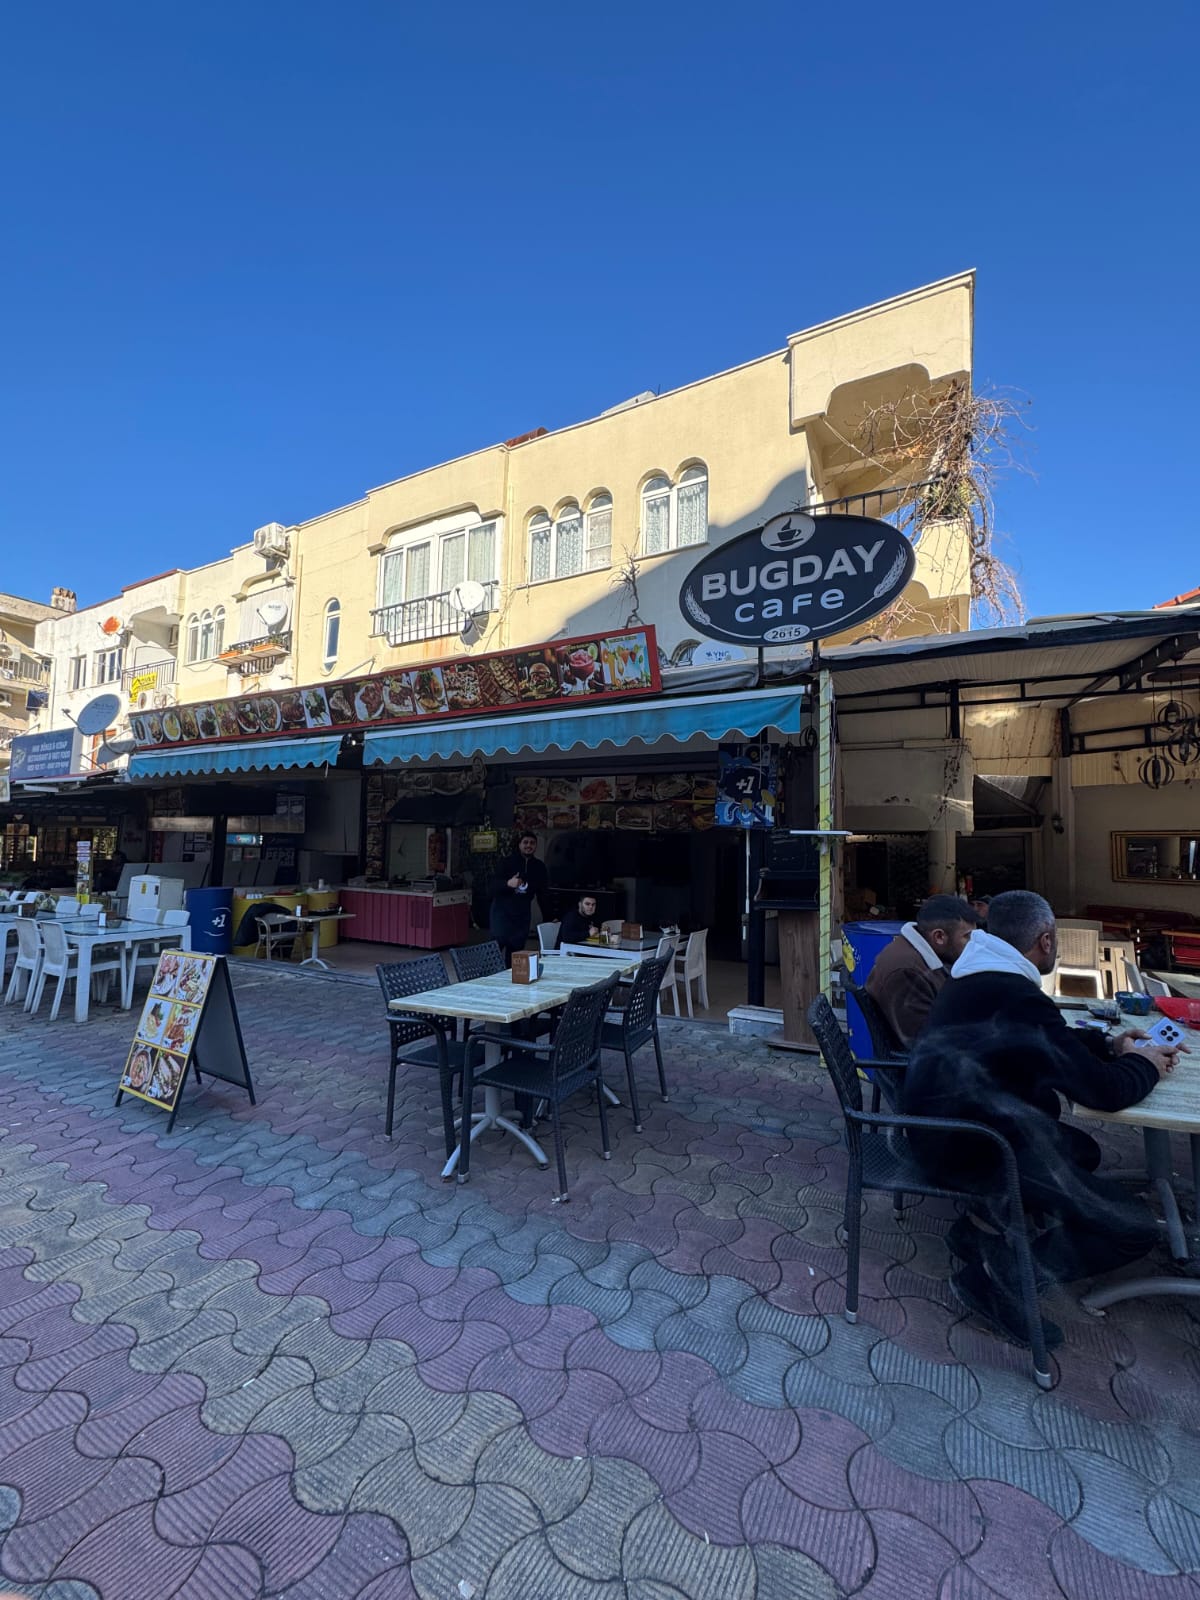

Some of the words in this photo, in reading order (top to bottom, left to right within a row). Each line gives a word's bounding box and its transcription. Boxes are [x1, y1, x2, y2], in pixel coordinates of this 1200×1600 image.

[702, 540, 885, 601] BUGDAY
[771, 627, 801, 639] 2015
[735, 775, 756, 795] +1
[211, 913, 226, 928] +1
